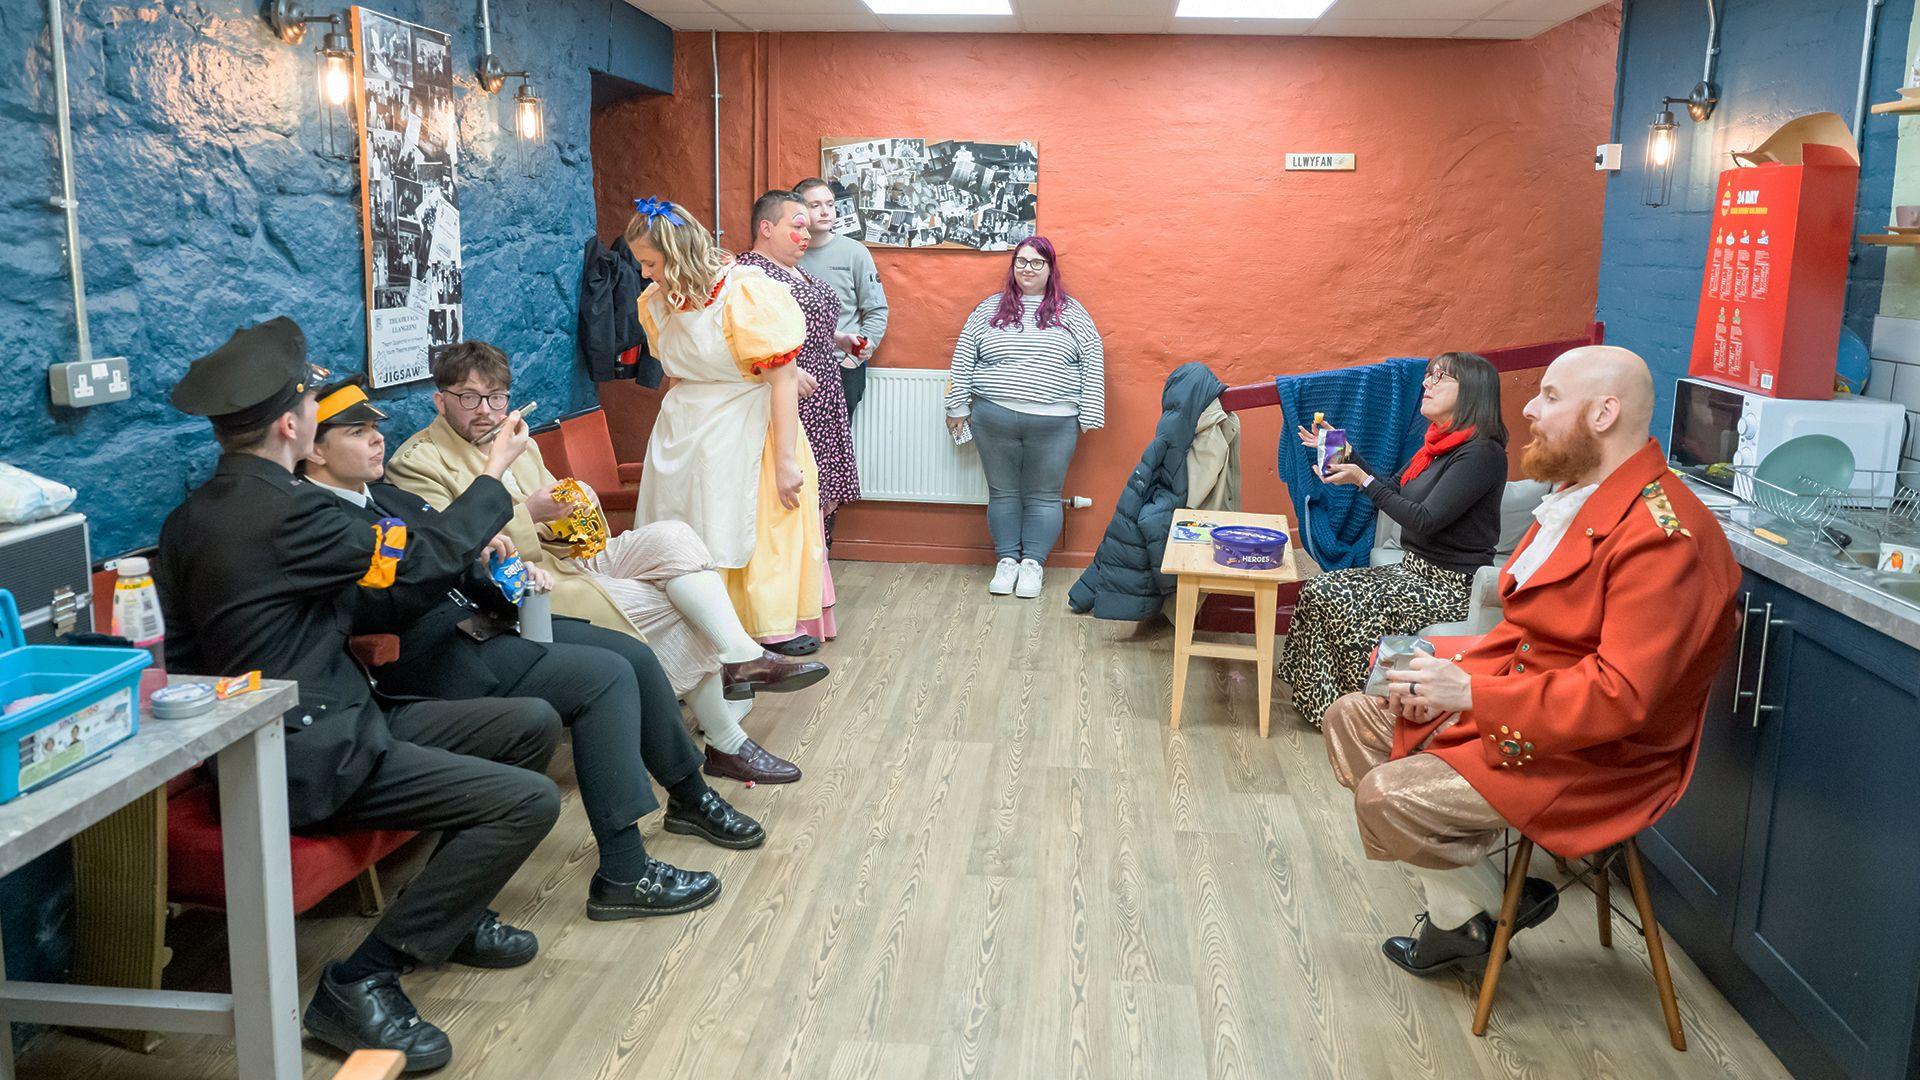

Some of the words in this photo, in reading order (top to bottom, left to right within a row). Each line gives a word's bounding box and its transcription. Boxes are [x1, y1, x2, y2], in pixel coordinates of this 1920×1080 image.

[1292, 156, 1333, 168] LLWYFAN
[1736, 190, 1745, 205] 24
[383, 366, 421, 384] JIGSAW
[1242, 555, 1270, 563] HEROES
